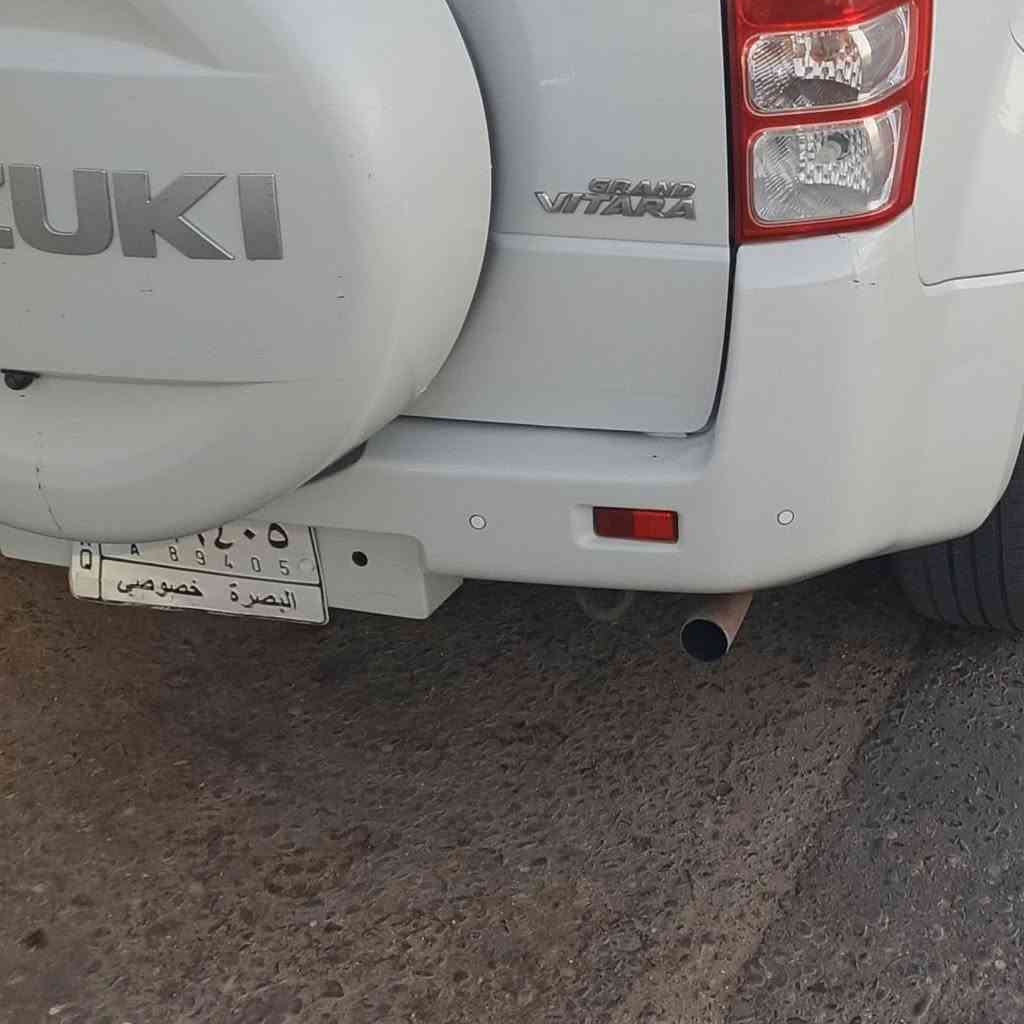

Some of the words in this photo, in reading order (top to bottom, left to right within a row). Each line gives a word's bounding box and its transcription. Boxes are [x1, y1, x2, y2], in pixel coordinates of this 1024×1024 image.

[587, 177, 697, 197] GRAND
[534, 190, 697, 220] VITARA
[117, 577, 204, 598] خصوصي
[229, 584, 297, 613] البصرة
